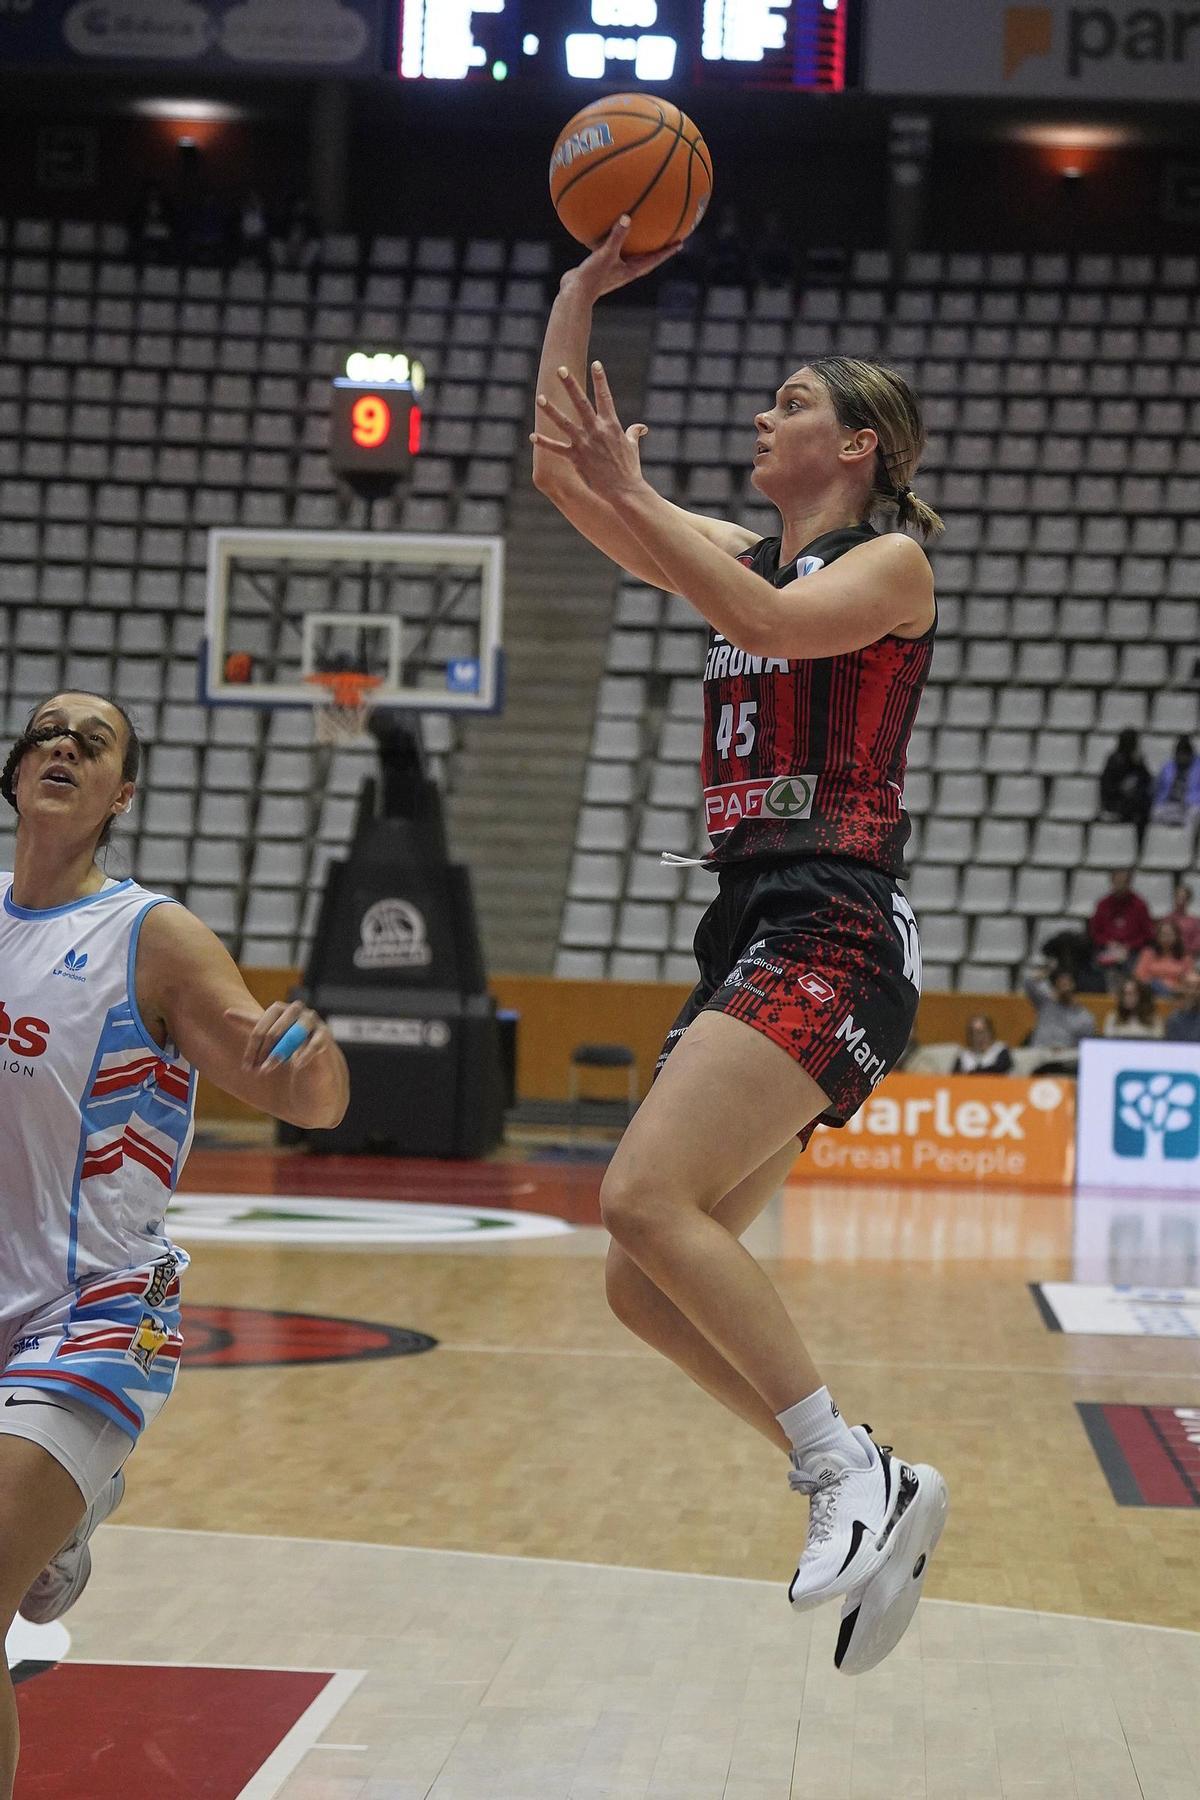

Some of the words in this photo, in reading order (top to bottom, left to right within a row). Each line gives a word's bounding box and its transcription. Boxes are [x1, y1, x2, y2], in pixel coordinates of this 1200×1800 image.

[352, 395, 391, 447] 9
[716, 701, 757, 760] 45
[753, 957, 784, 975] Girona
[742, 981, 766, 997] Girona
[812, 1137, 903, 1169] Great
[913, 1139, 1026, 1176] People
